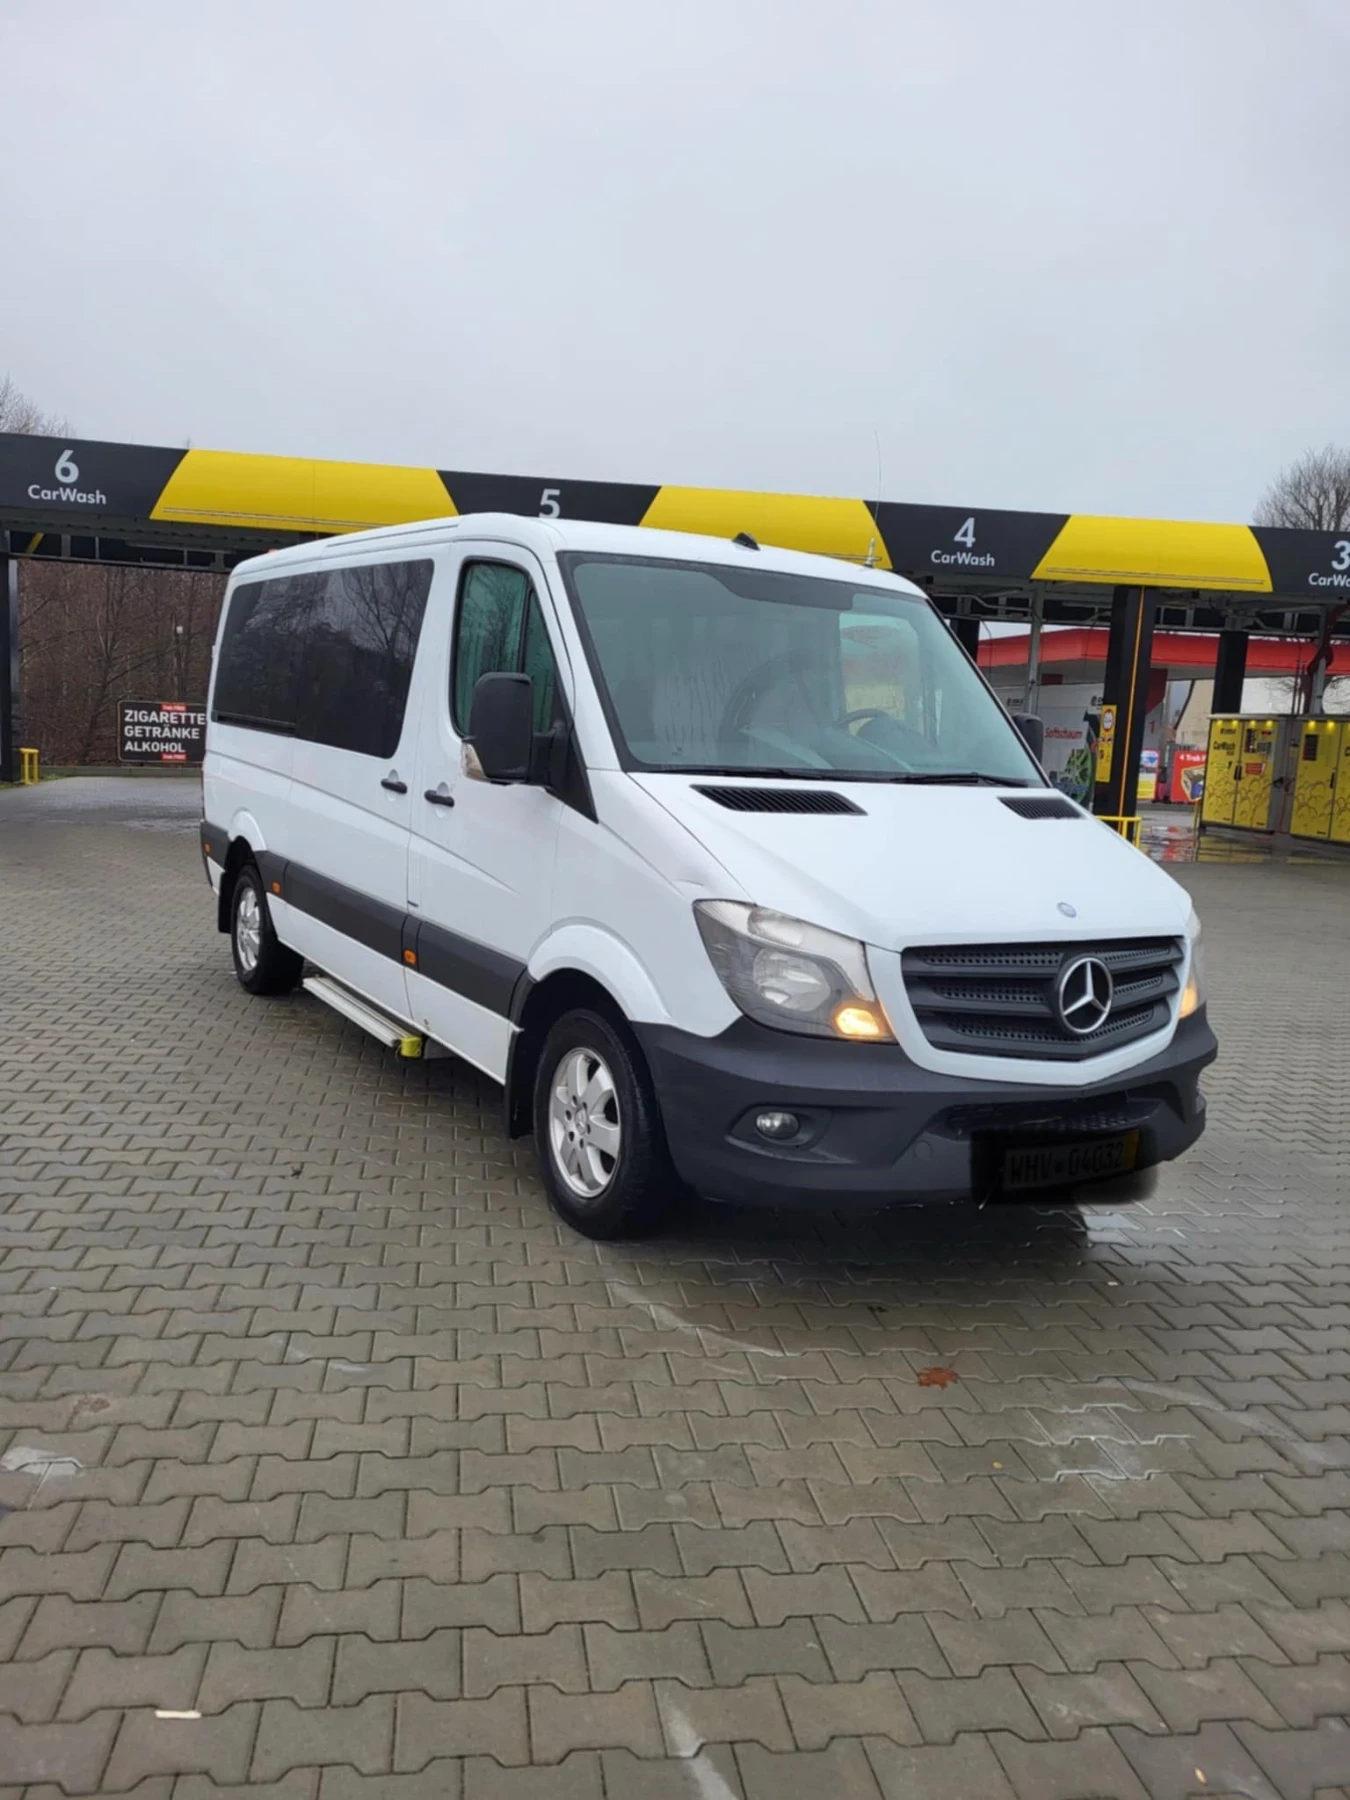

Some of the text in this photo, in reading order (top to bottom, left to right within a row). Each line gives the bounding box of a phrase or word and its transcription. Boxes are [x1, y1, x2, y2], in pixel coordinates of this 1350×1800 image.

[54, 449, 79, 484] 6
[27, 484, 108, 506] CarWash
[538, 488, 561, 519] 5
[953, 516, 976, 548] 4
[930, 549, 996, 567] CarWash
[1330, 539, 1350, 571] 3
[124, 724, 200, 739] GETRÄNKE
[124, 741, 186, 753] ALKOHOL
